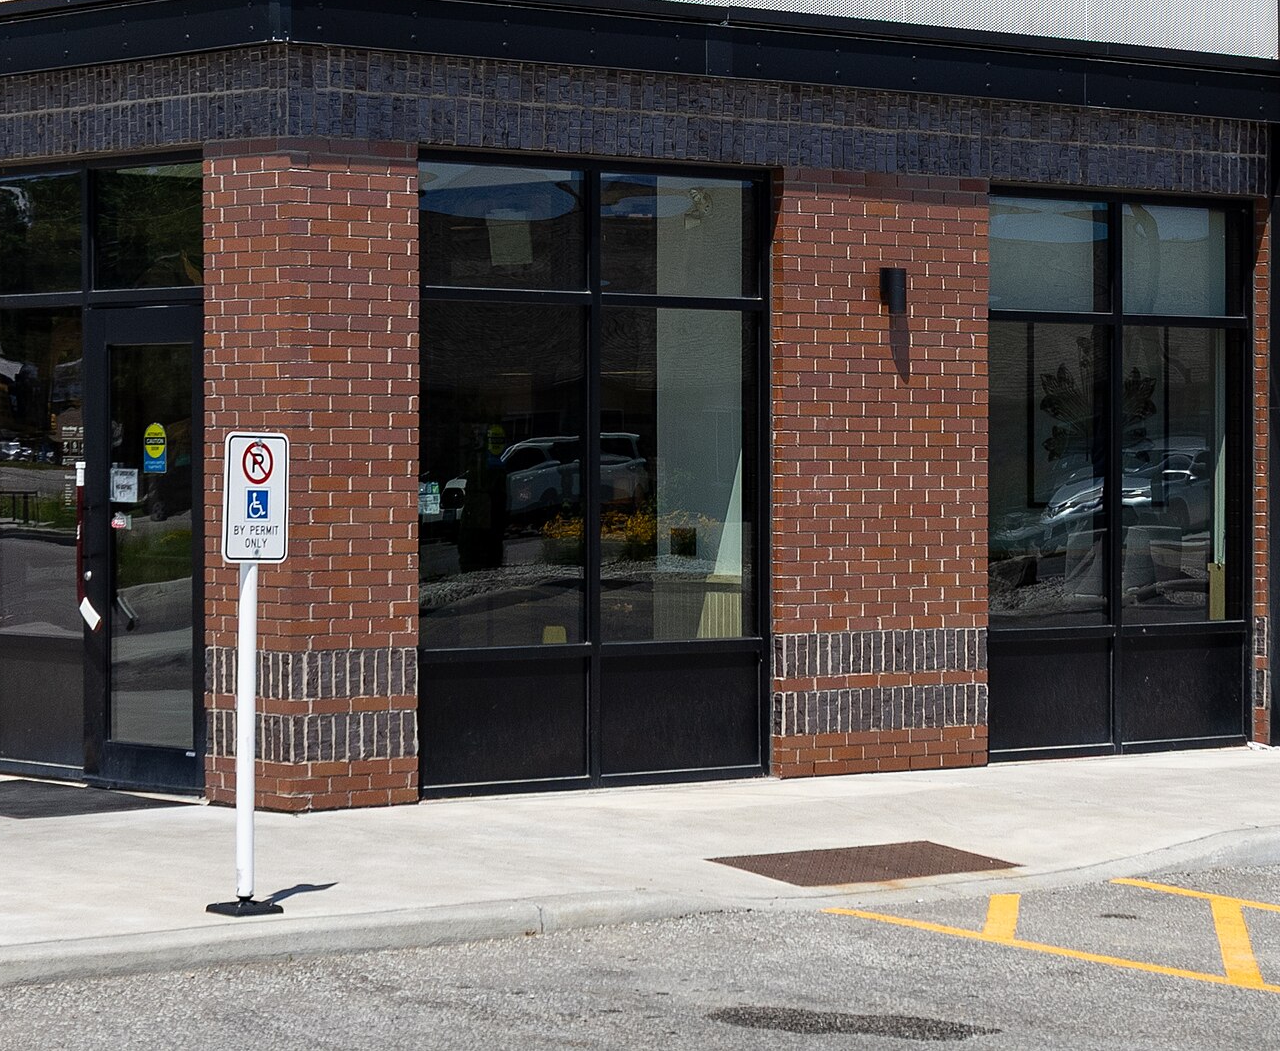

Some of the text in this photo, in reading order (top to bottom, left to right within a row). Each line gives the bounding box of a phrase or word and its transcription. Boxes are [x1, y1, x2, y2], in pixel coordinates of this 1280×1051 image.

[233, 525, 279, 536] BY PERMIT
[245, 538, 268, 548] ONLY
